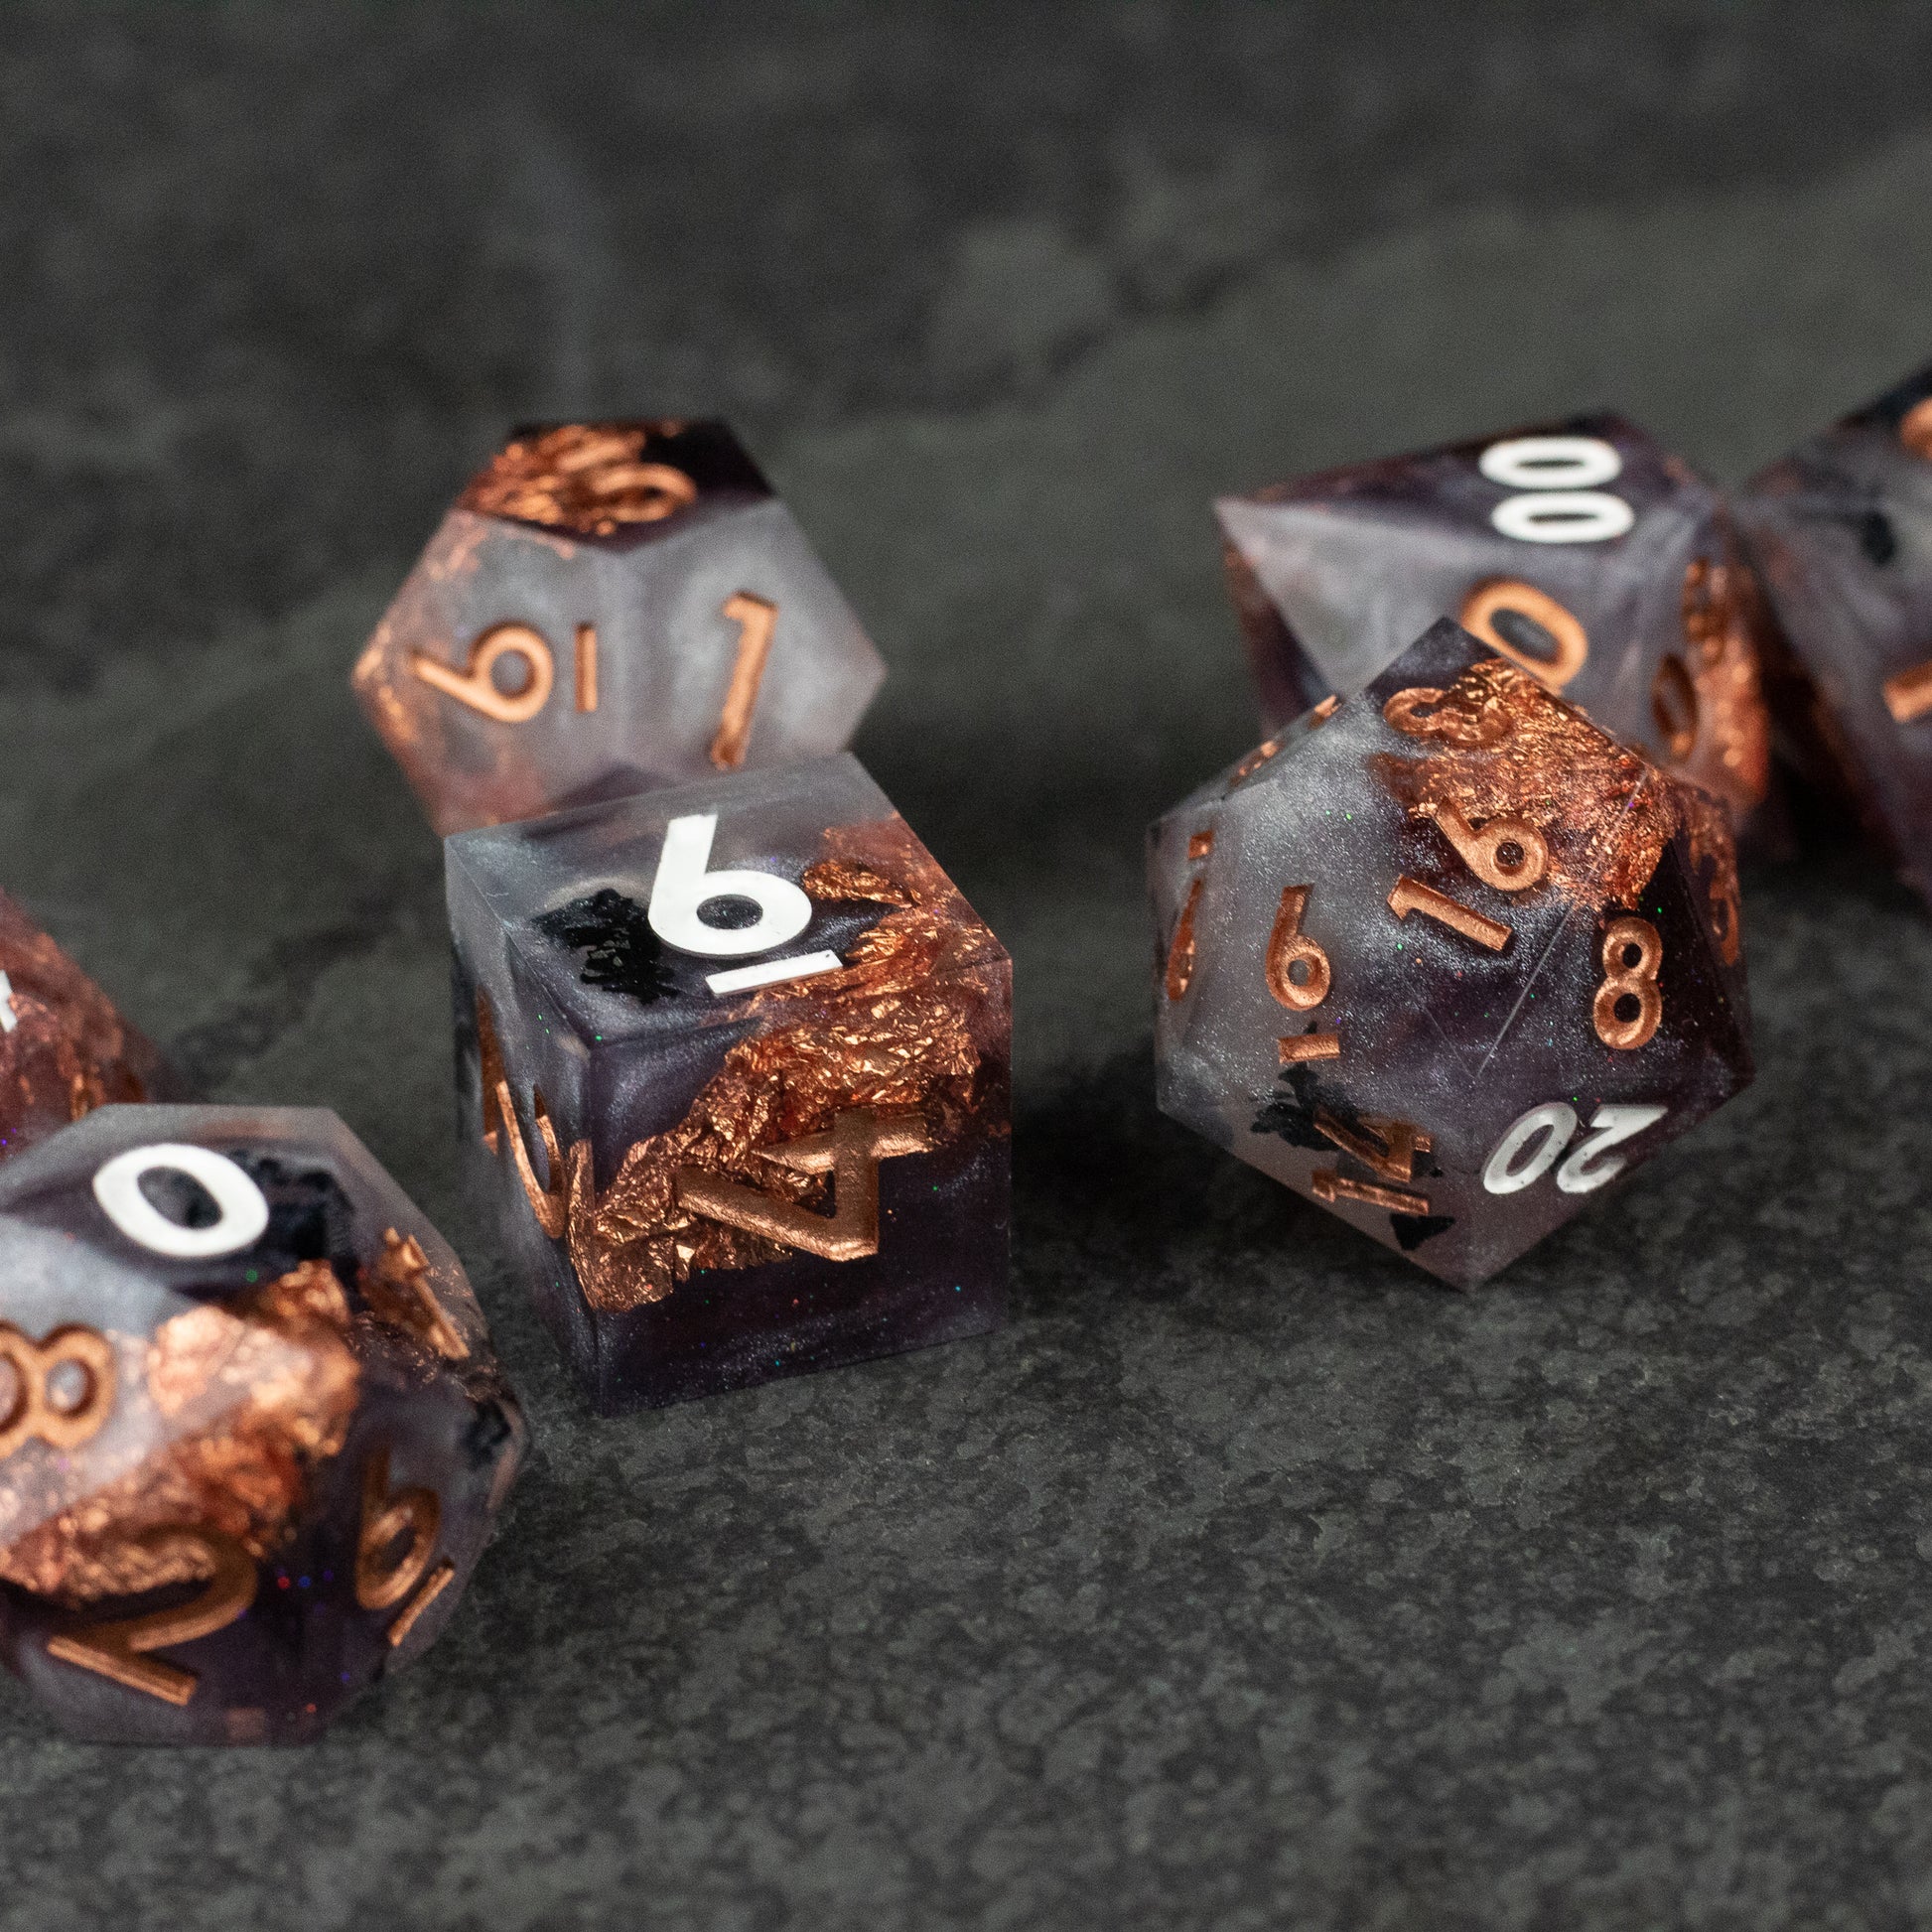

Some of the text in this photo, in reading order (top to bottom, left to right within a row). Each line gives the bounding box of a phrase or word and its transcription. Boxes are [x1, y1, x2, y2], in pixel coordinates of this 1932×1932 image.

[1479, 435, 1635, 544] 00
[410, 621, 554, 724] 6
[647, 813, 812, 958] 6
[1387, 796, 1550, 952] 16
[1265, 884, 1332, 1012] 6
[1592, 916, 1664, 1051] 8
[92, 1143, 269, 1258] 0
[673, 1108, 933, 1263] 4
[1483, 1101, 1670, 1195] 20
[355, 1447, 441, 1611] 6
